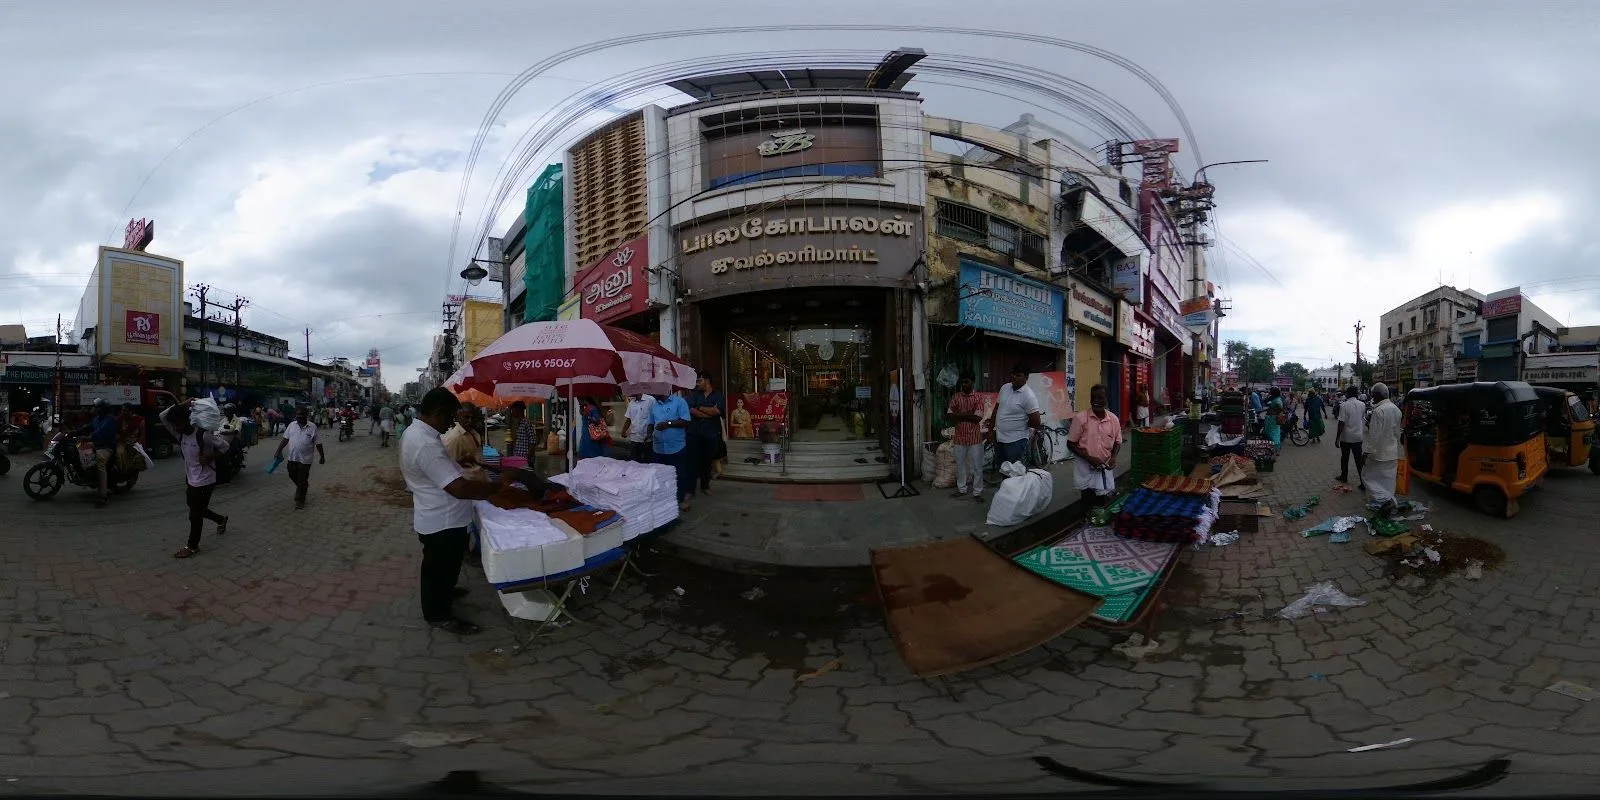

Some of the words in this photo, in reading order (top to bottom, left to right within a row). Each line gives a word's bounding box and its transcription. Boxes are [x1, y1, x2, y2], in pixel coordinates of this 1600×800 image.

[682, 214, 914, 254] பாலகோபாலன்
[585, 265, 632, 304] அனு
[964, 311, 996, 325] RANI
[997, 317, 1036, 334] MEDICAL
[1038, 327, 1059, 339] MART
[6, 370, 19, 378] THE
[20, 371, 48, 379] MODERN
[514, 359, 542, 371] 97916
[543, 358, 576, 368] 95067
